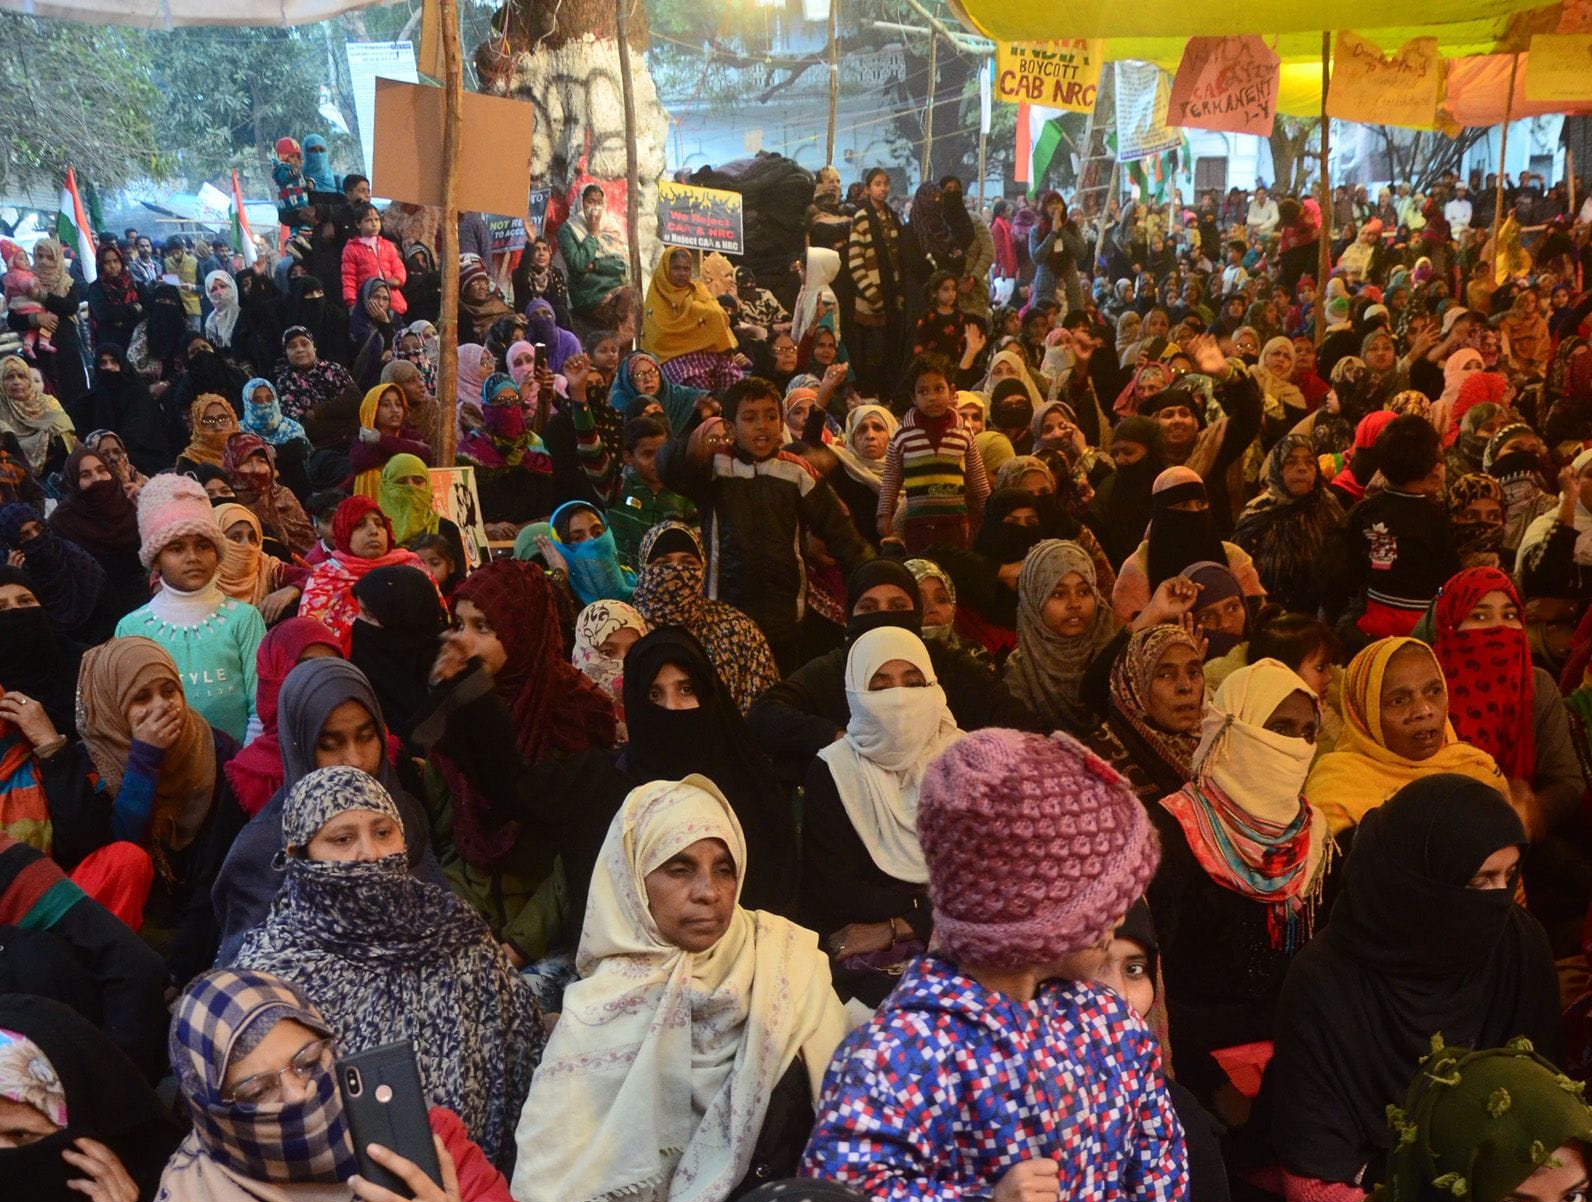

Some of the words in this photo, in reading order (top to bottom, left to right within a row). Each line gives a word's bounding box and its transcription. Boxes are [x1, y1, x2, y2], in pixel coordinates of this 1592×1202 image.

[1019, 58, 1079, 80] BOYCOTT
[1000, 70, 1045, 99] CAB
[1052, 79, 1096, 107] NRC
[490, 220, 512, 231] NOT
[511, 215, 543, 228] REDY
[669, 210, 688, 220] We
[691, 213, 730, 227] Reject
[495, 231, 505, 239] TO
[667, 222, 691, 233] CAA
[696, 227, 705, 236] &
[708, 228, 735, 240] NRC
[722, 240, 738, 250] NRC
